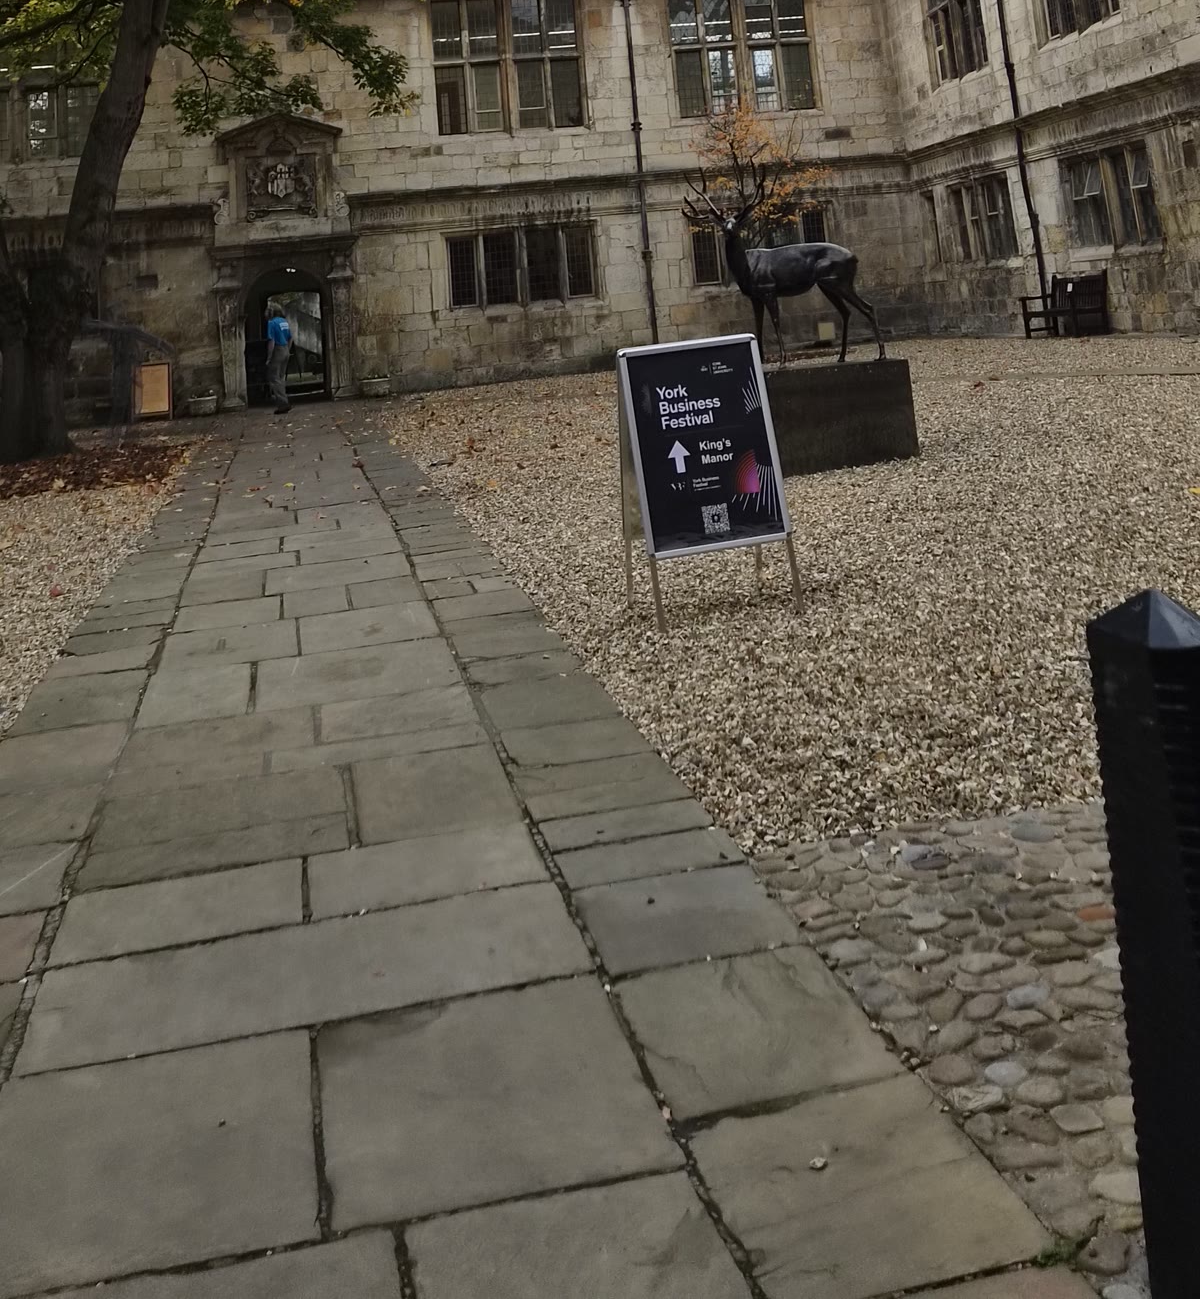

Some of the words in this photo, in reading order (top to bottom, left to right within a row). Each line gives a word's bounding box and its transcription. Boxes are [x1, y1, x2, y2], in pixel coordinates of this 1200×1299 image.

[656, 384, 688, 400] York
[659, 398, 721, 415] Business
[661, 410, 714, 430] Festival
[699, 438, 732, 451] King's
[701, 453, 734, 464] Manor
